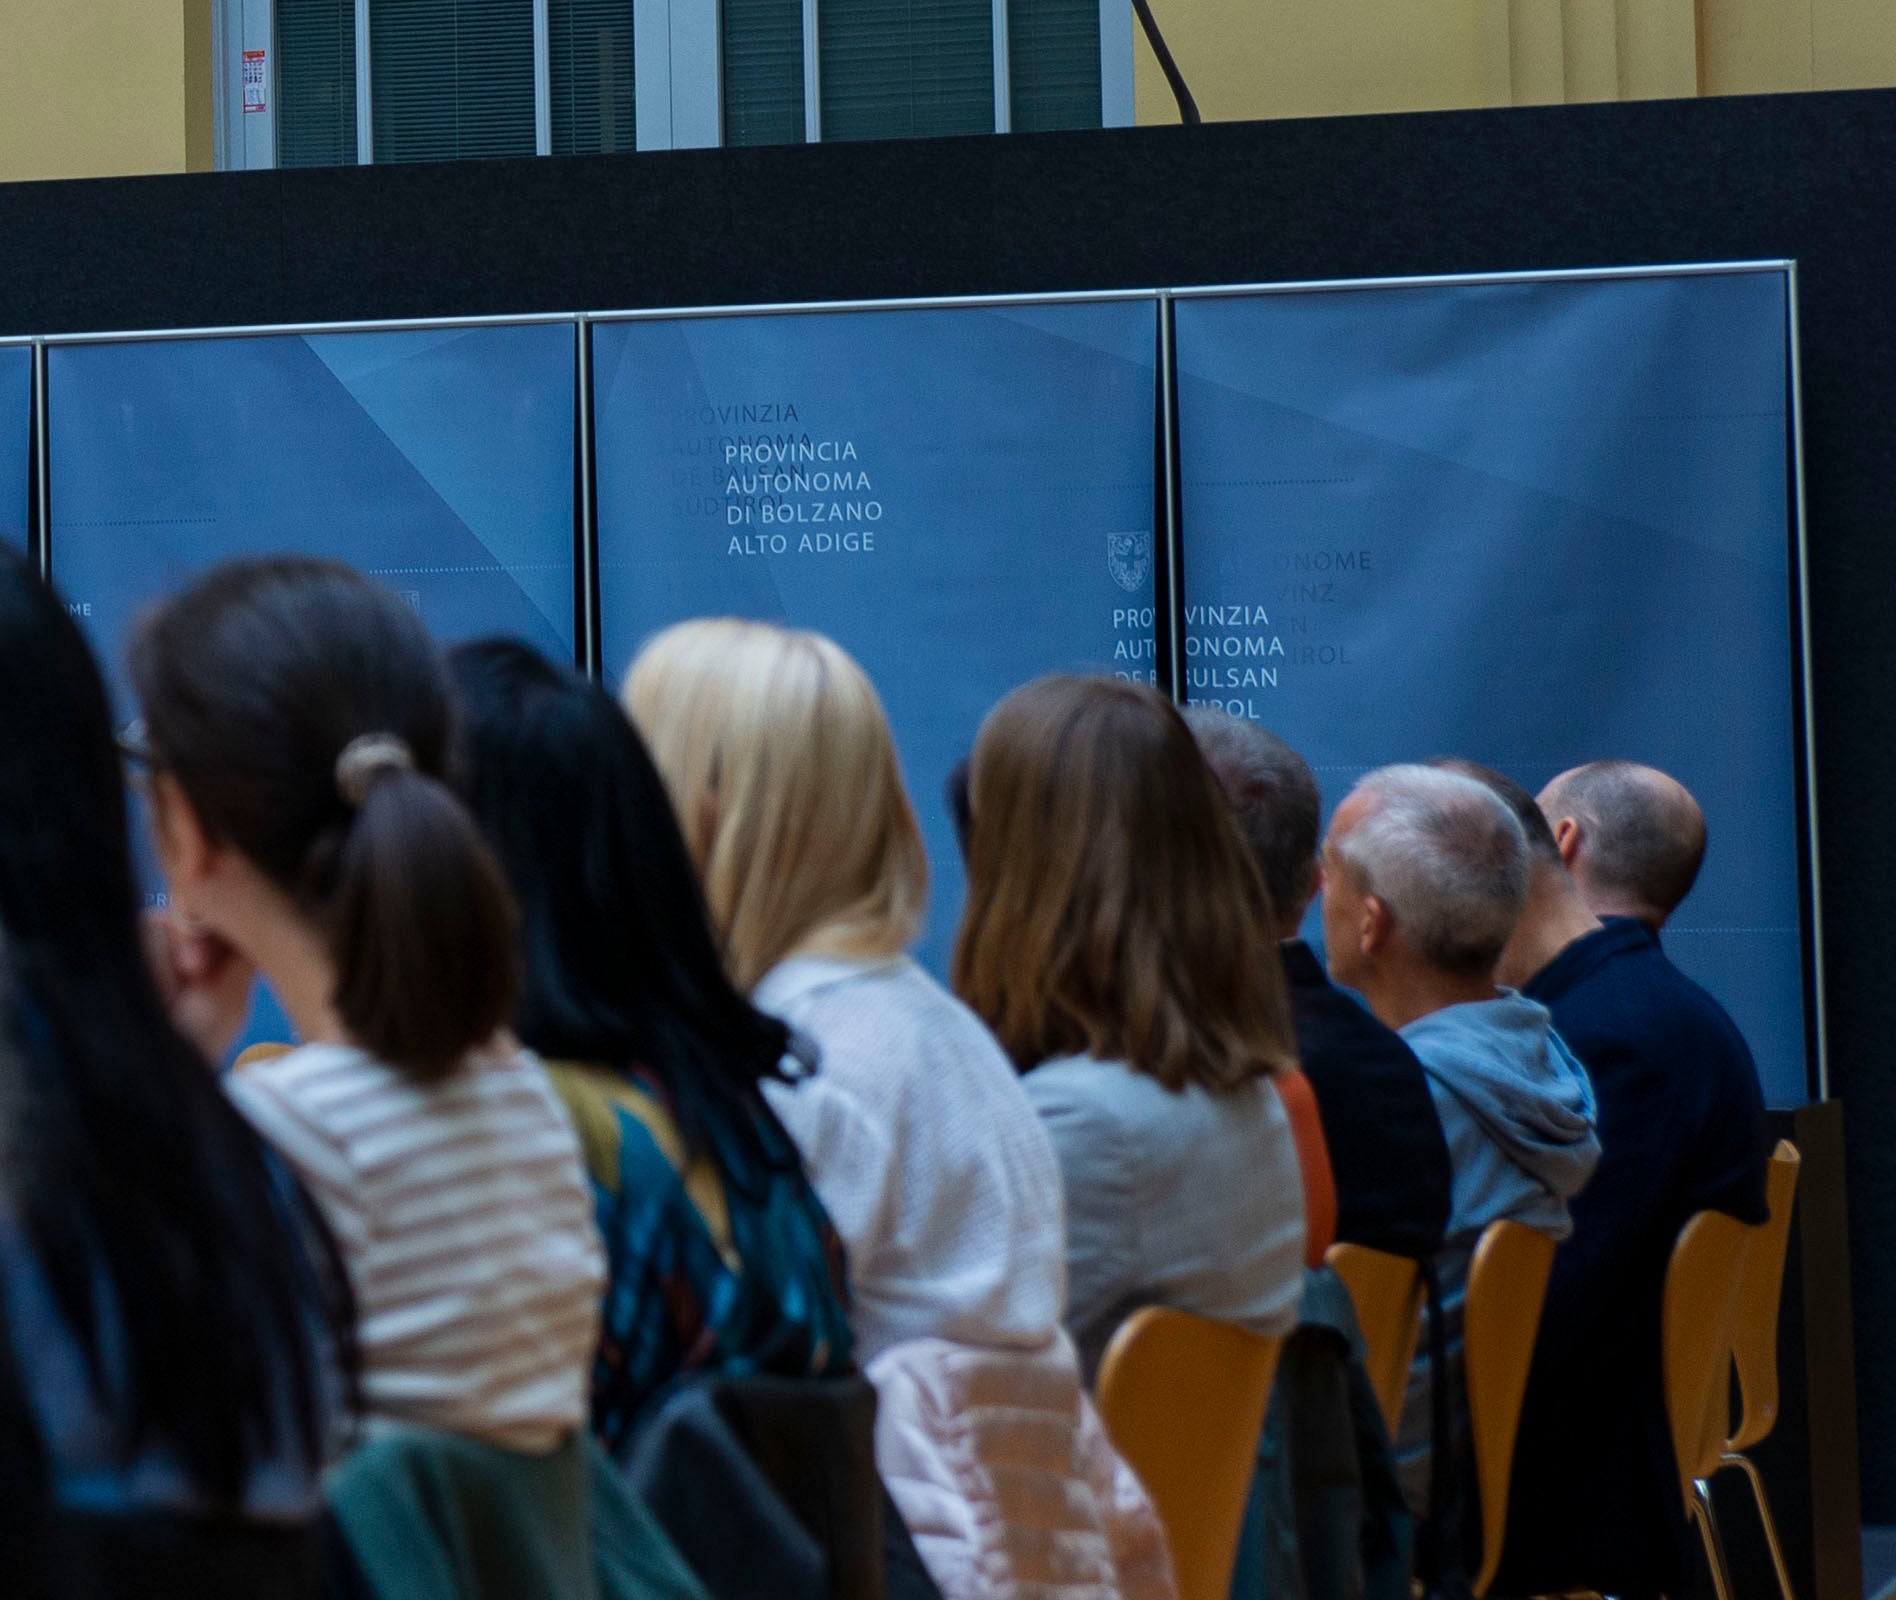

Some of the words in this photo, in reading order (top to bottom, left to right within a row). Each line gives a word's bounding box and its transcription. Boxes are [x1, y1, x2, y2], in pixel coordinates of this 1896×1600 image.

[725, 441, 858, 465] PROVINCIA
[726, 471, 872, 495] AUTONOMA
[727, 504, 751, 525] DI
[762, 500, 883, 524] BOLZANO
[727, 534, 788, 555] ALTO
[798, 531, 875, 553] ADIGE
